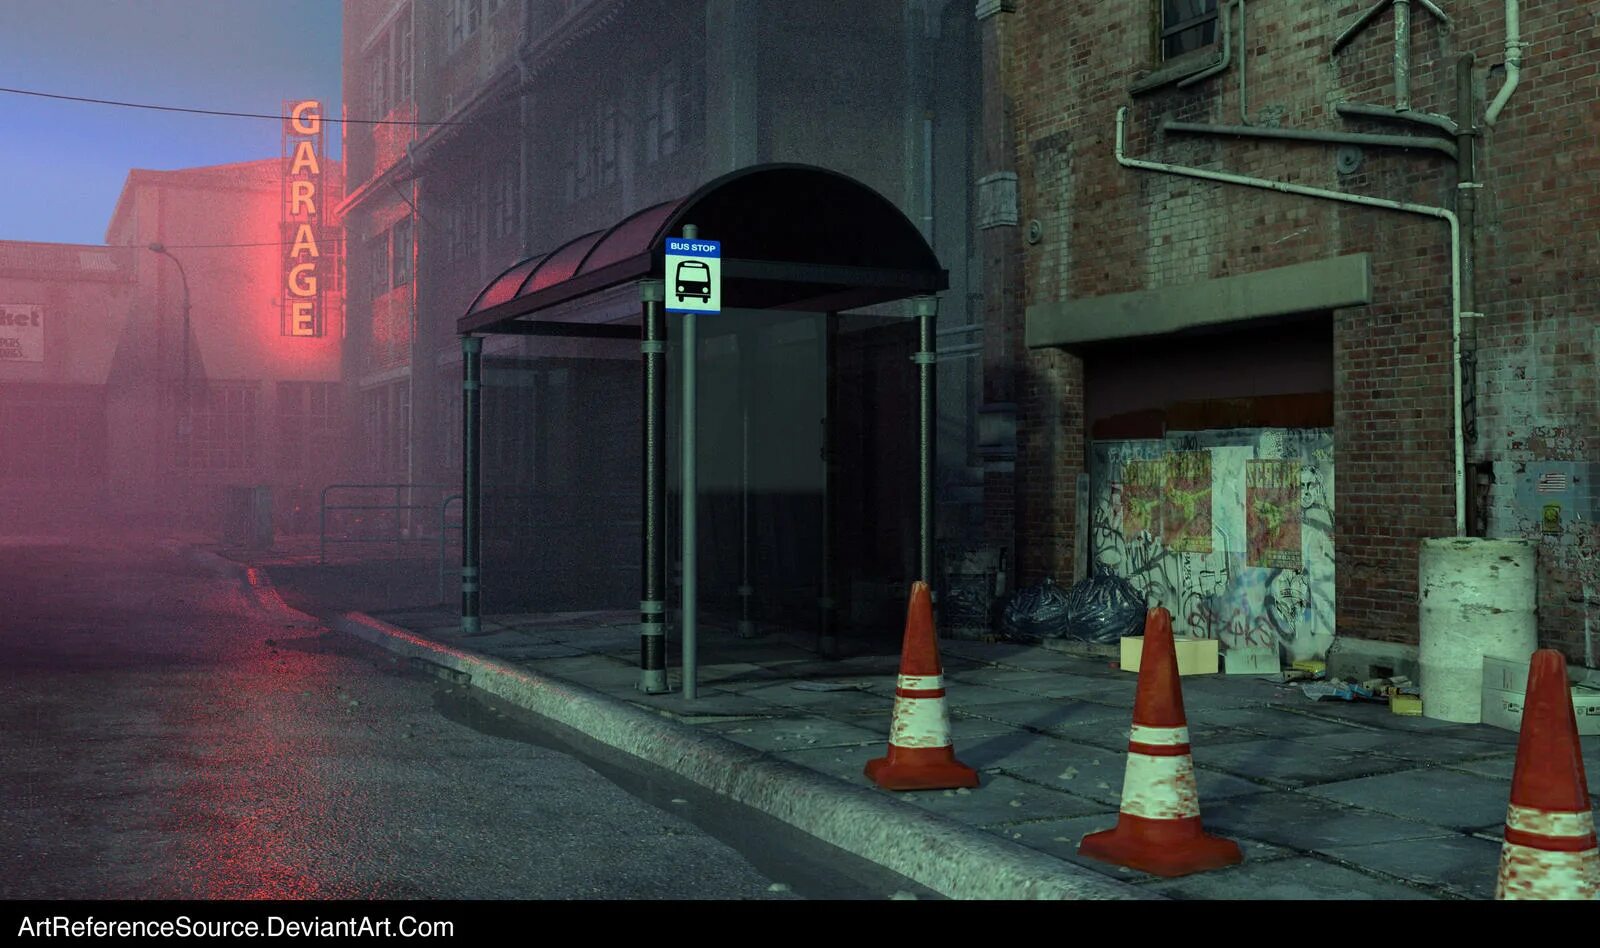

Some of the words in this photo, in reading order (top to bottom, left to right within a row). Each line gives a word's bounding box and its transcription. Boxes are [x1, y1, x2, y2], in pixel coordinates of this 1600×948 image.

[288, 101, 321, 336] GARAGE
[670, 242, 690, 250] BUS
[691, 243, 716, 252] STOP
